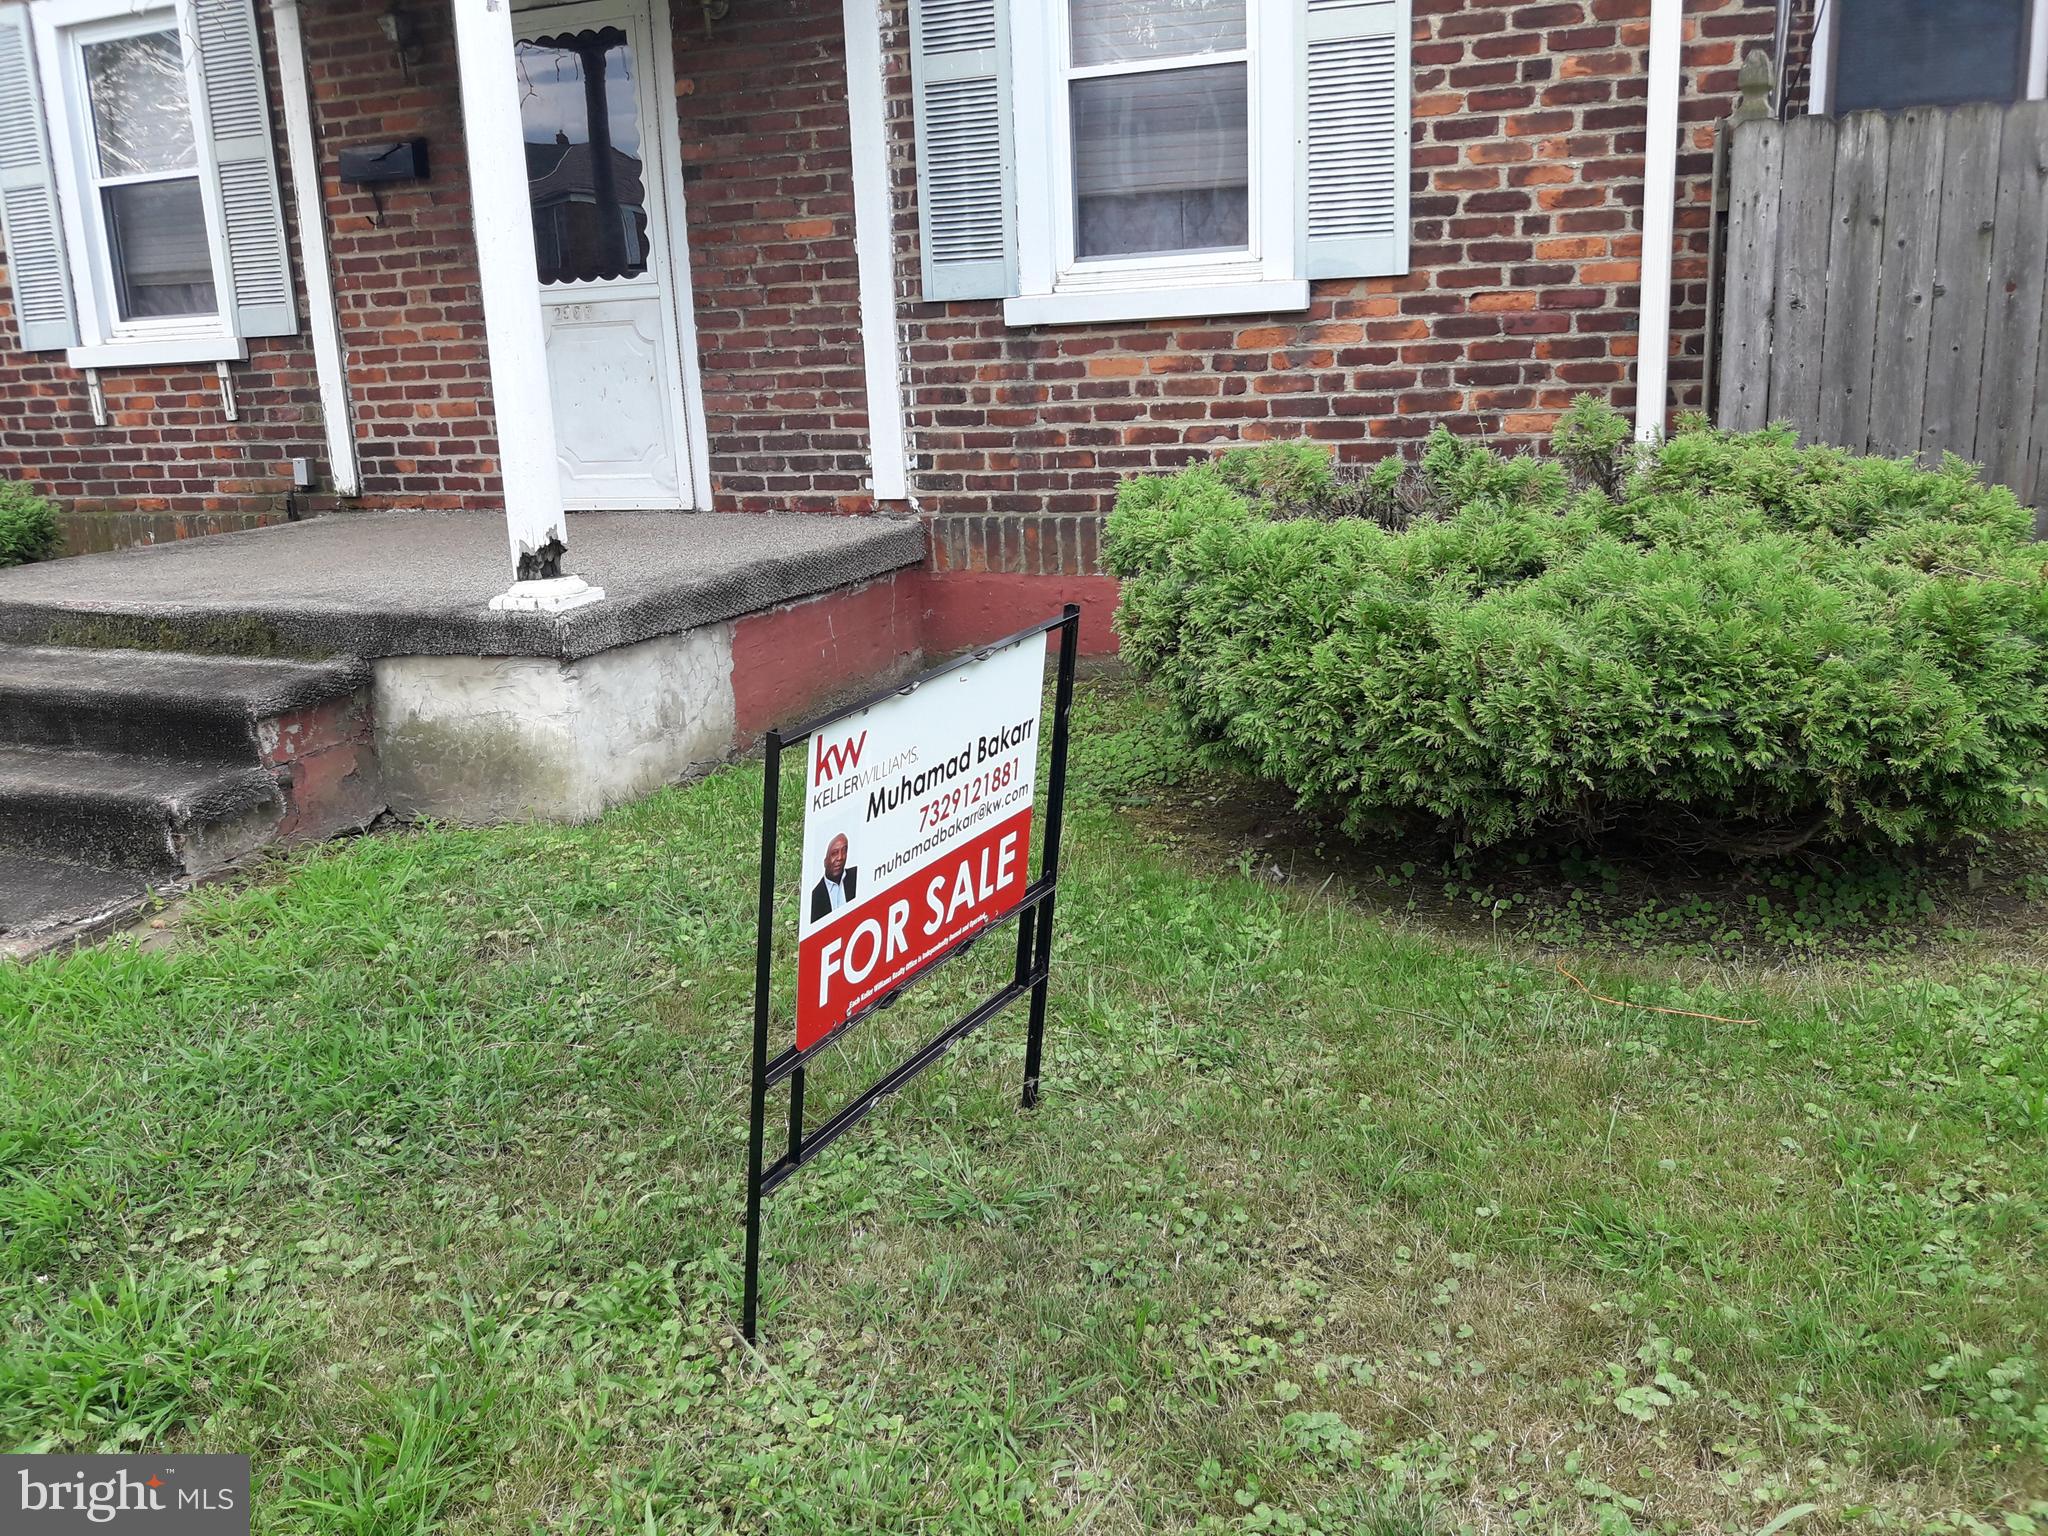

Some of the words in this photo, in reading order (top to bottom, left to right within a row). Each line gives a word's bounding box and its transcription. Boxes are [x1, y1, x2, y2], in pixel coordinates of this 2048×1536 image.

[866, 742, 971, 822] Muhamad
[977, 718, 1034, 764] Bakarr
[919, 757, 1019, 833] 7329121881
[874, 783, 1028, 881] muhamadbakarr@kw.com
[819, 899, 910, 1009] FOR
[923, 830, 1018, 936] SALE
